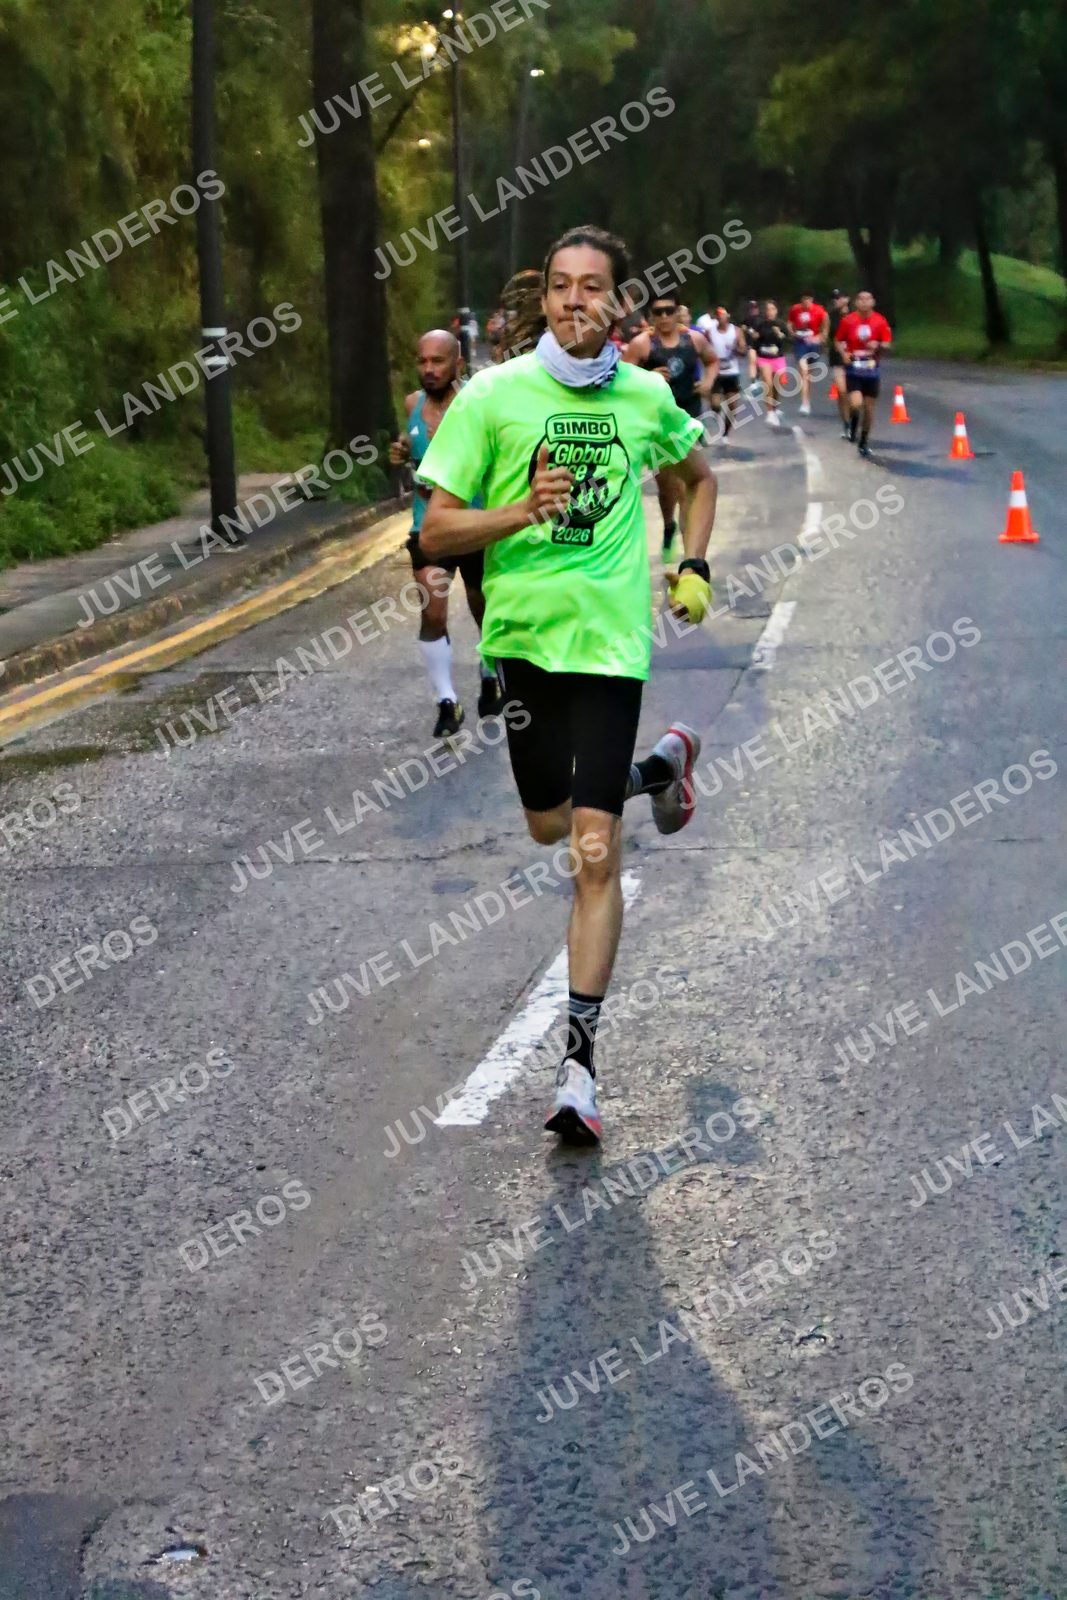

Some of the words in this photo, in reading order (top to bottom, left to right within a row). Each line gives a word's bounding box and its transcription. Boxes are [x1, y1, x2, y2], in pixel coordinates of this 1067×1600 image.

[553, 421, 611, 436] BIMBO
[554, 443, 611, 464] Global
[554, 526, 591, 543] 2026
